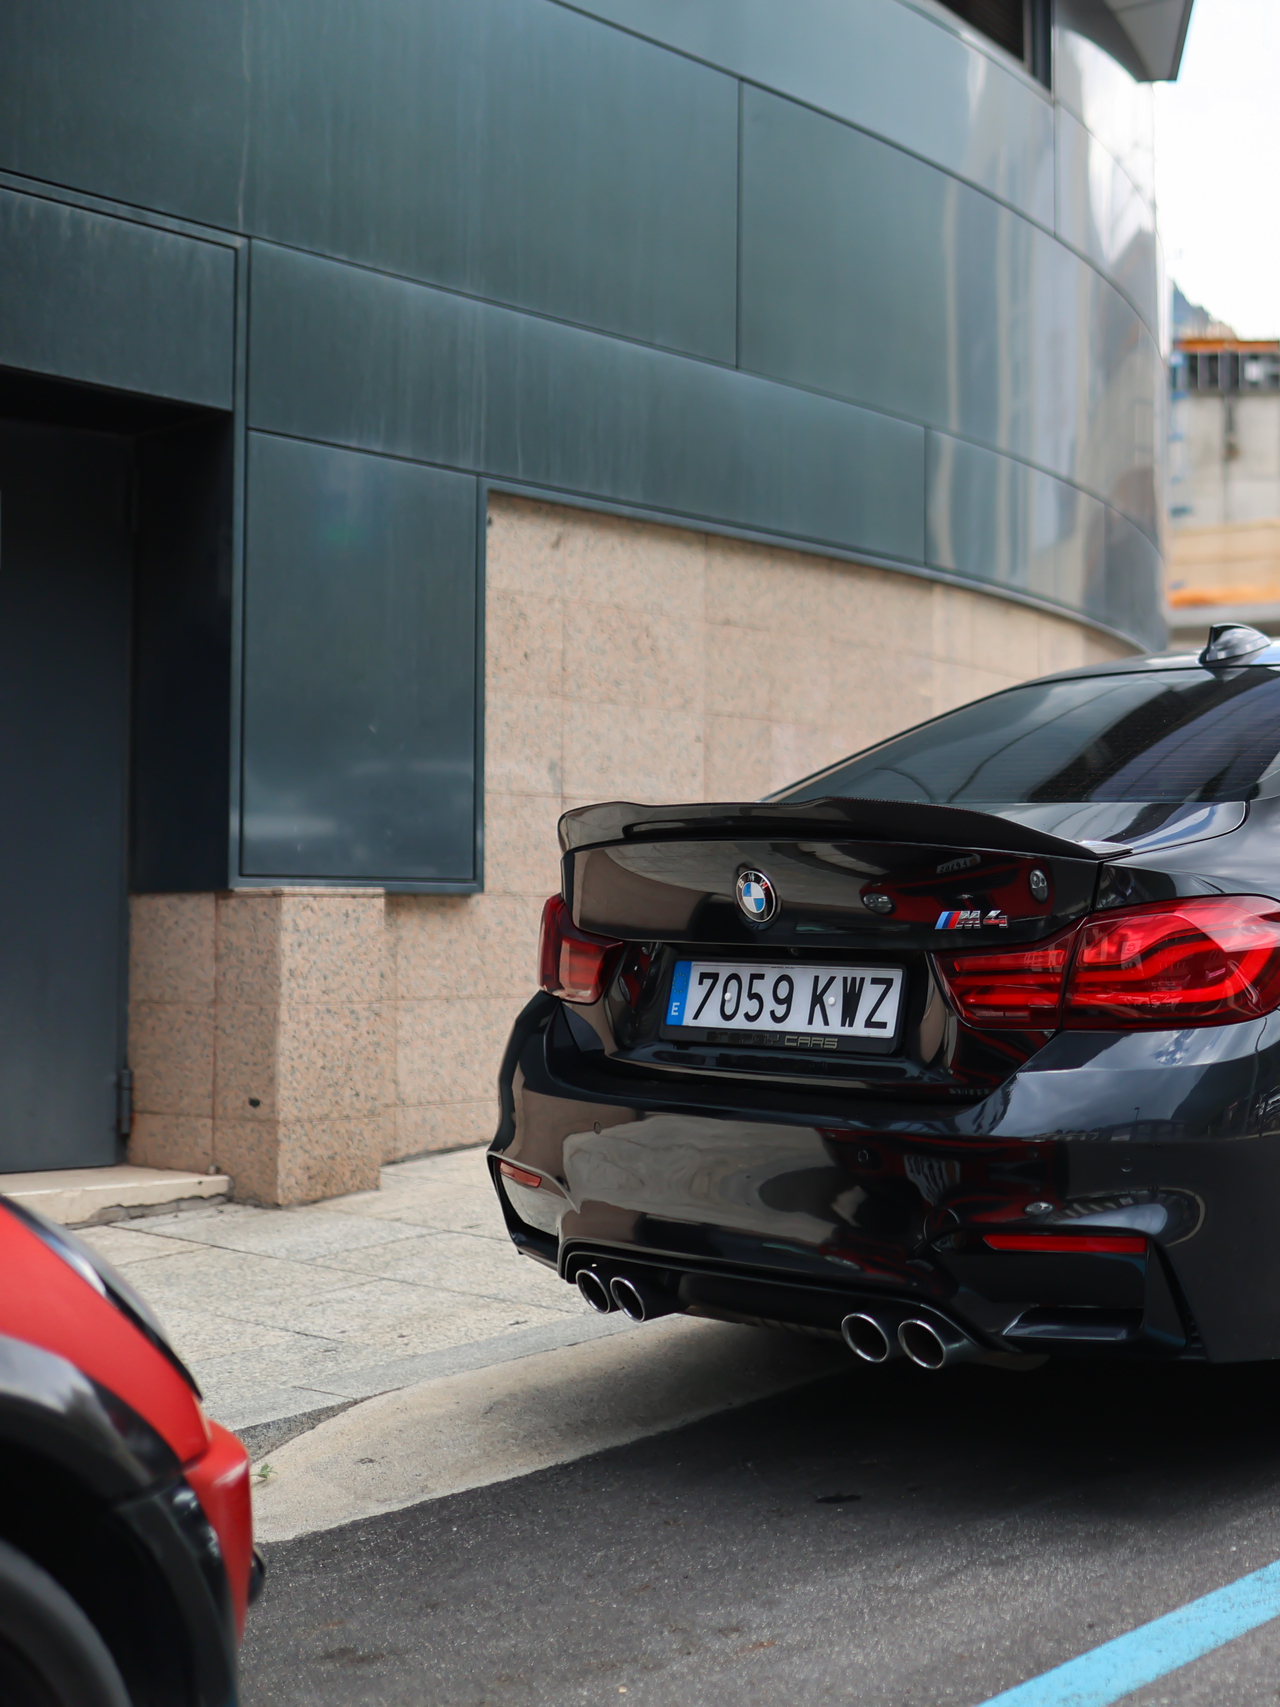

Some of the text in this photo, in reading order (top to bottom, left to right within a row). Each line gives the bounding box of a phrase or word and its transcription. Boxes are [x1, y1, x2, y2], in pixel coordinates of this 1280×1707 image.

[738, 872, 769, 889] BMW
[692, 971, 894, 1030] 7059 KWZ
[670, 1002, 680, 1016] E
[784, 1034, 839, 1050] CARS
